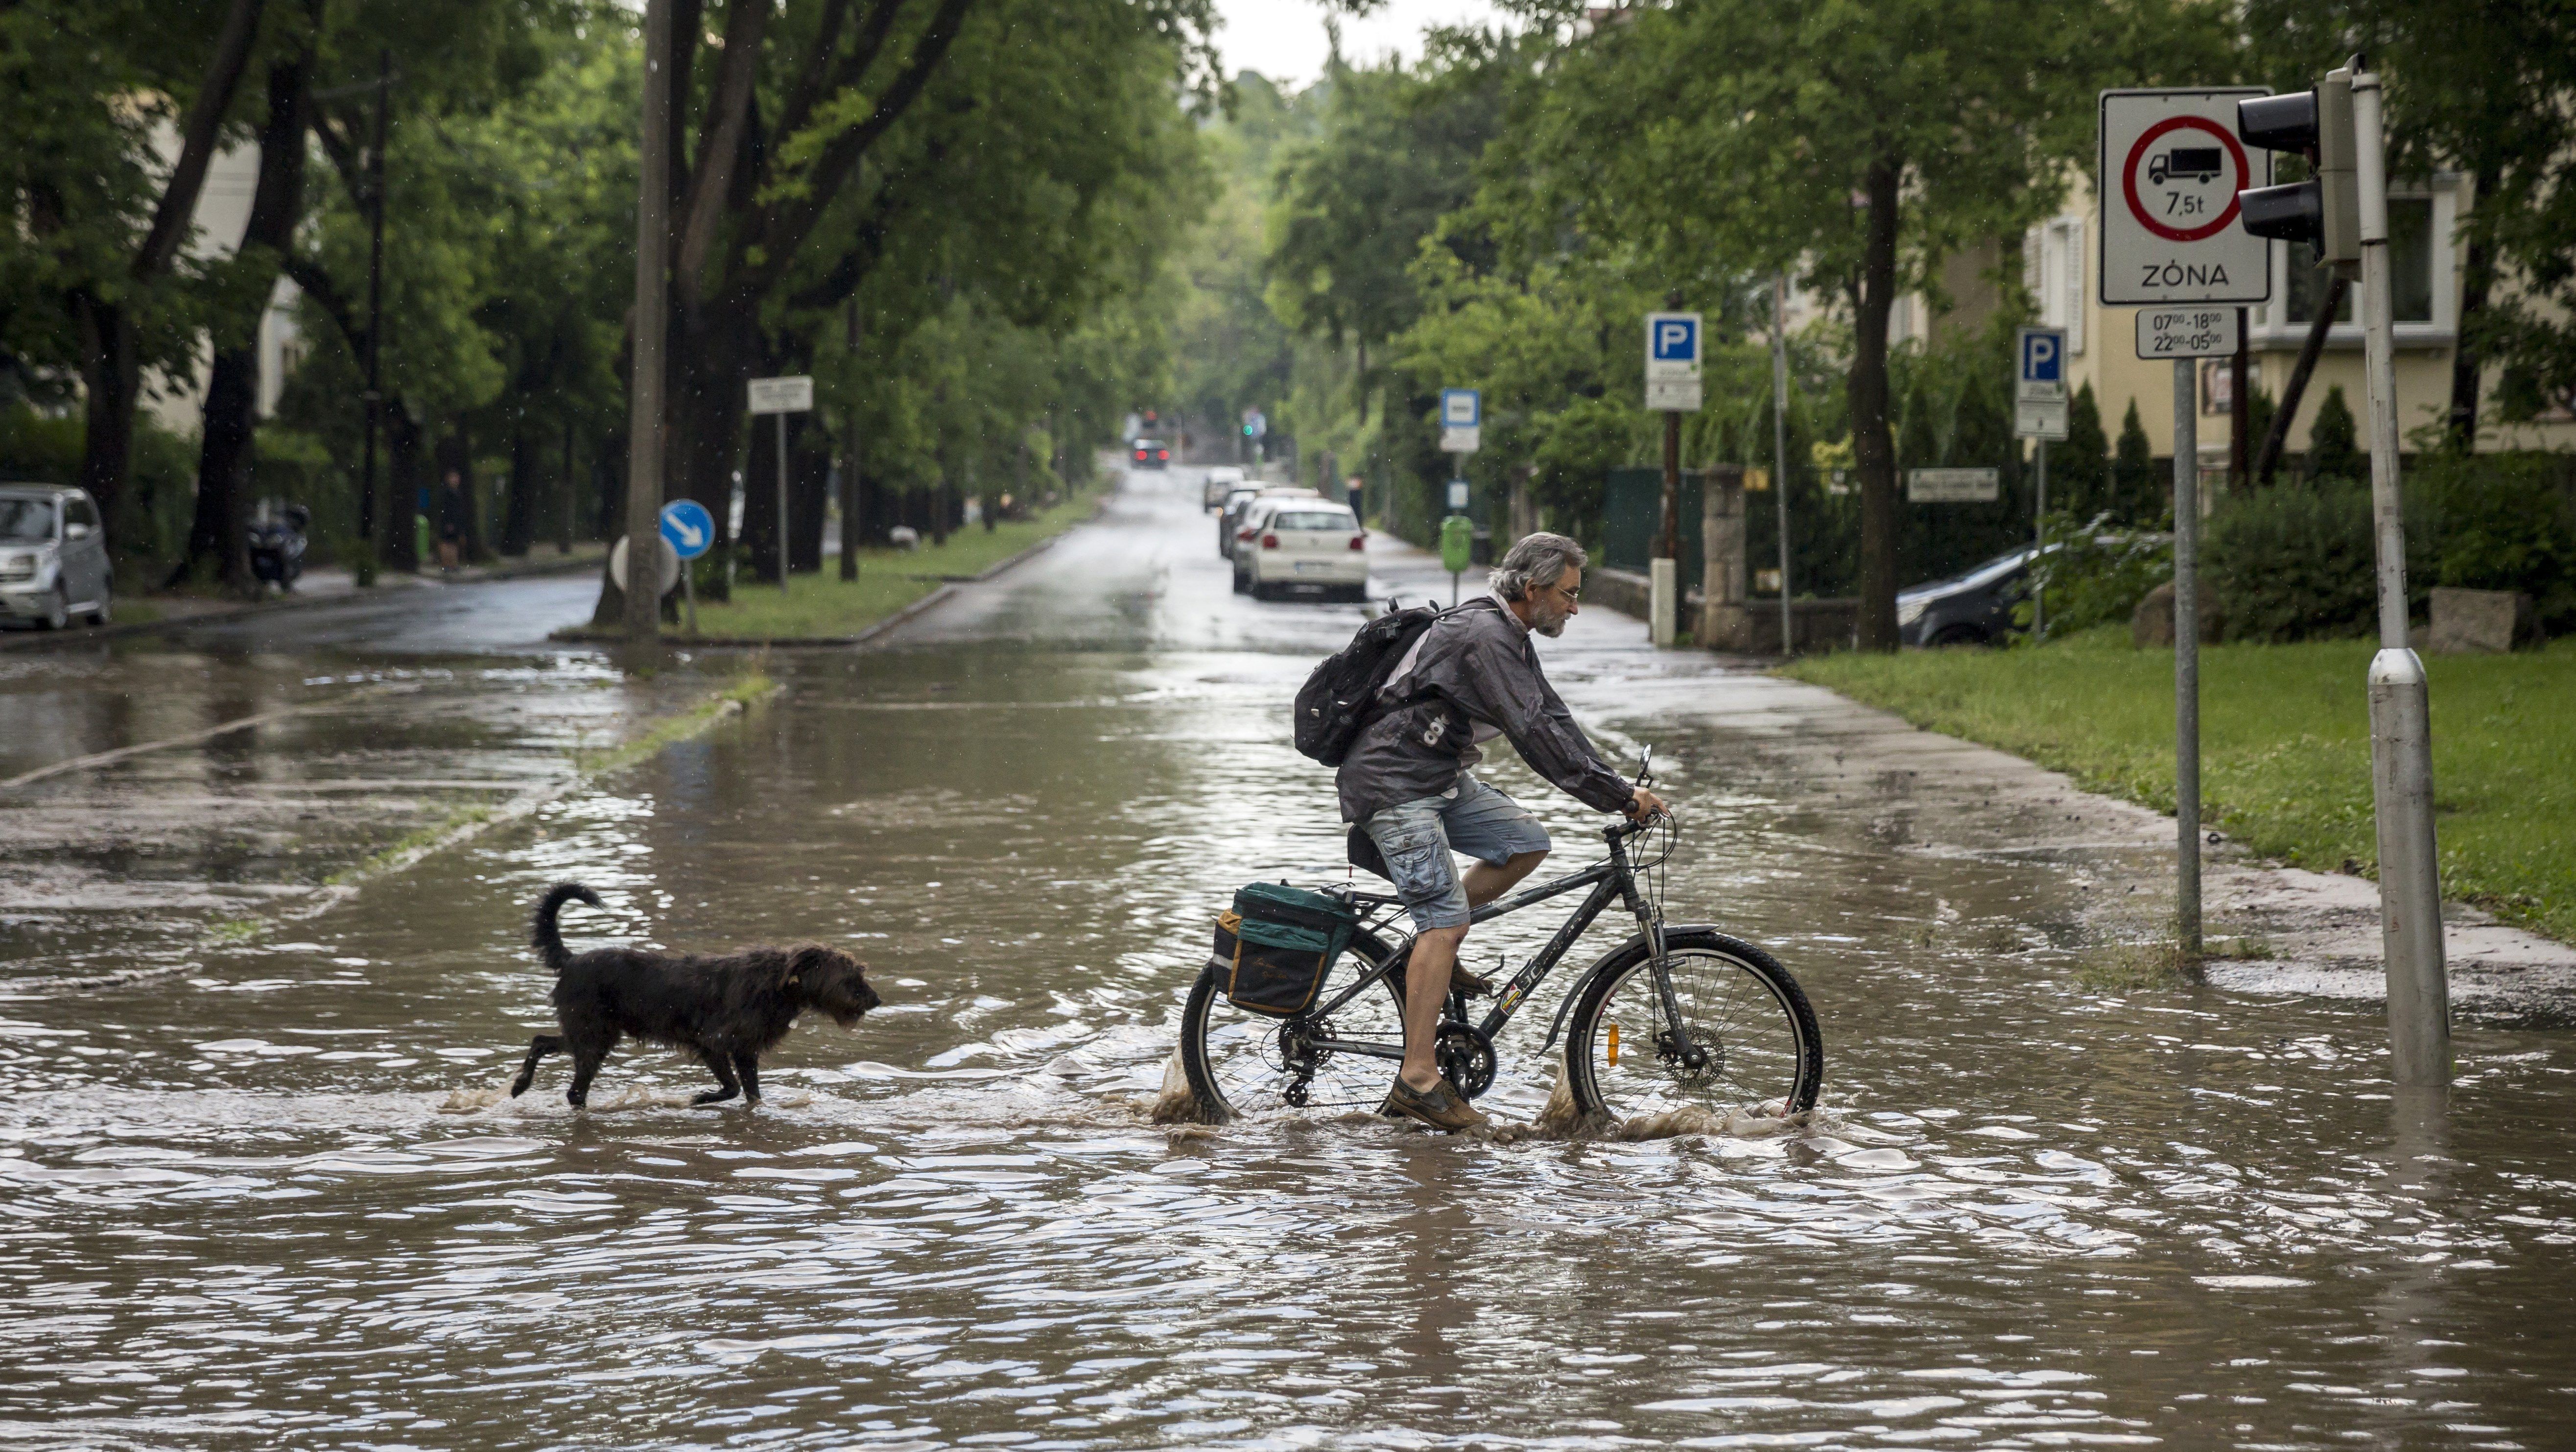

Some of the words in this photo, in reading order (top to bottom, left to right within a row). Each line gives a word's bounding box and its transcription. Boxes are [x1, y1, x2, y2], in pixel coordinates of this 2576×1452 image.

[2166, 191, 2203, 216] 7,5t
[2142, 258, 2229, 287] ZÓNA
[1660, 324, 1688, 355] P
[2030, 336, 2054, 377] P
